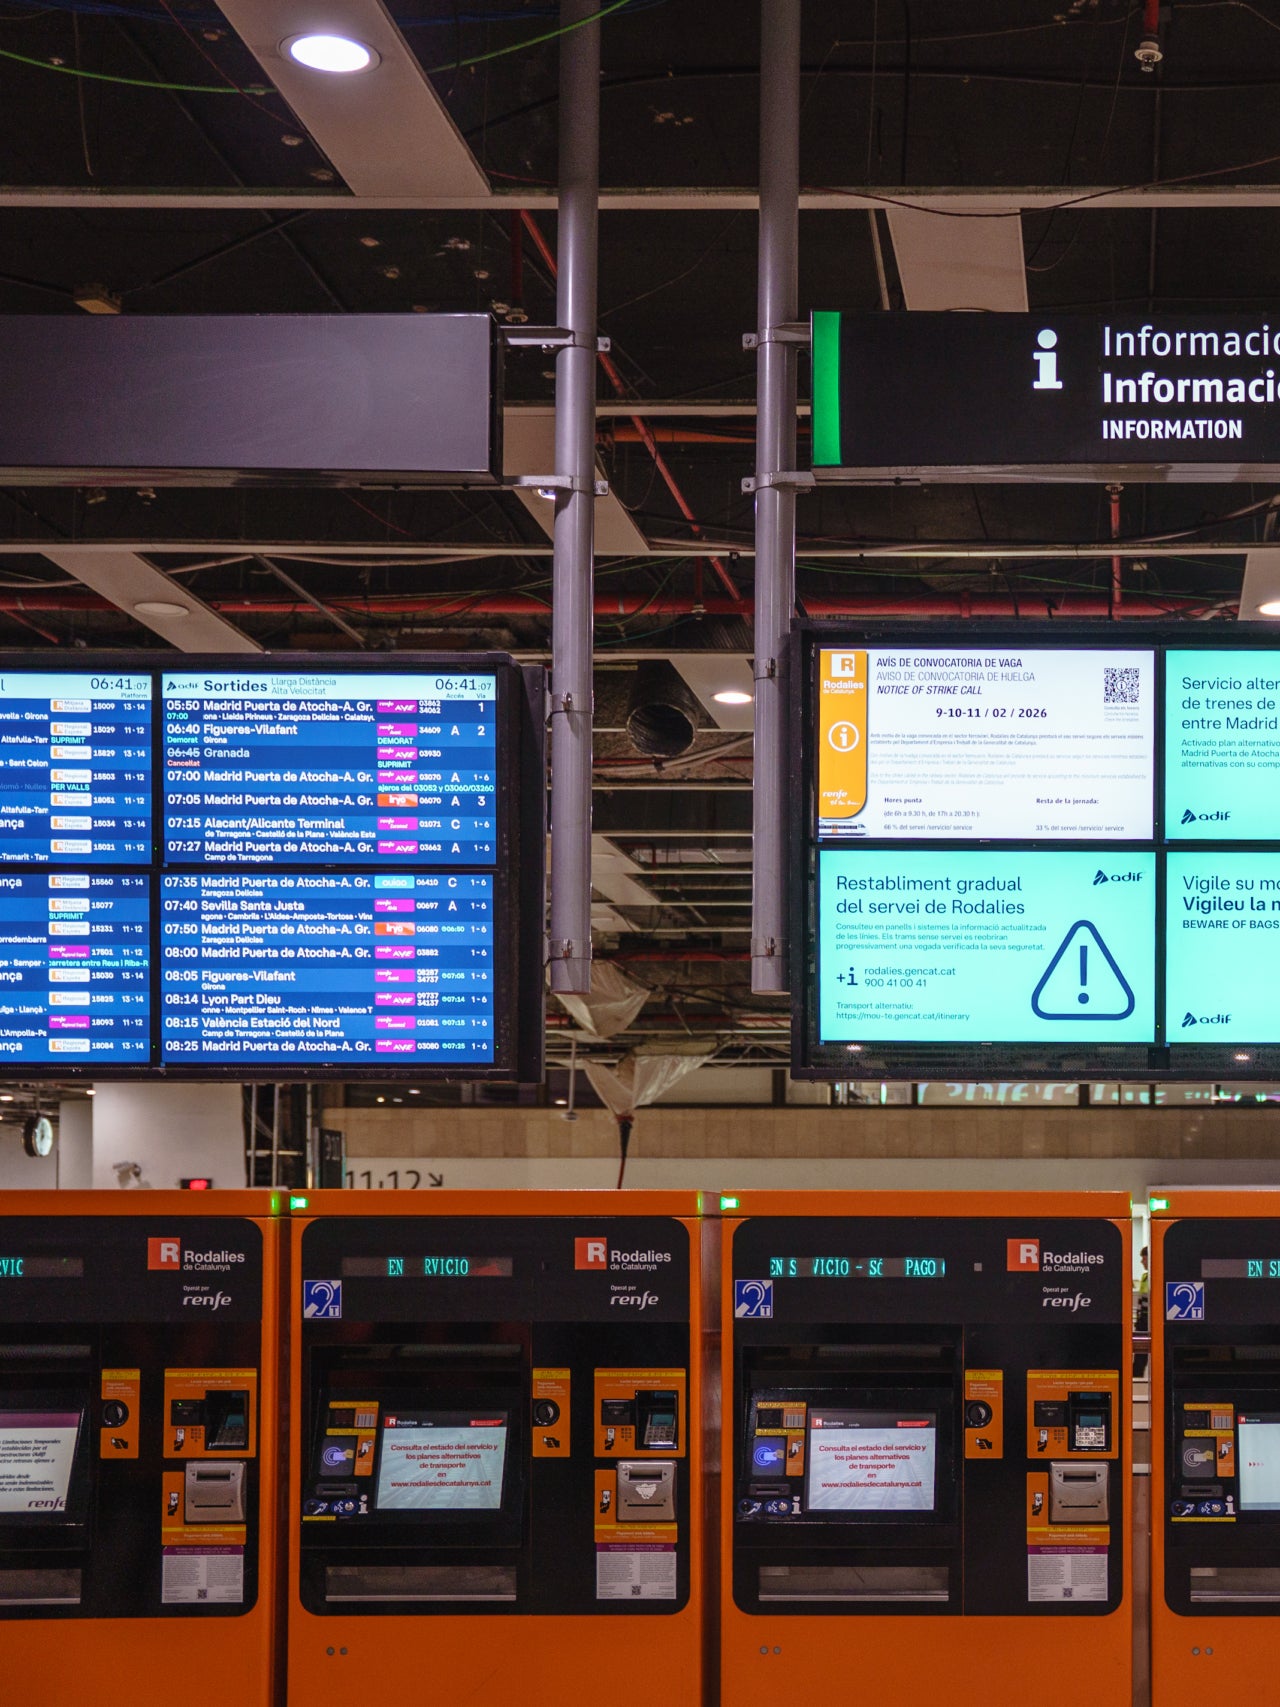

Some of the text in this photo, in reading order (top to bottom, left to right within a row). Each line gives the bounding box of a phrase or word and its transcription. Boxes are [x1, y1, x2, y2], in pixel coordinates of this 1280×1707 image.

[1103, 420, 1242, 439] INFORMATION
[877, 656, 1022, 668] AVÍS DE CONVOCATORIA DE VAGA
[877, 672, 1035, 682] AVISO DE CONVOCATORIA DE HUELGA
[204, 680, 267, 692] Sortides
[271, 678, 336, 687] Llarga Distància
[823, 680, 864, 689] Rodalies
[1183, 677, 1242, 690] Servicio
[271, 687, 326, 695] Alta Velocitat
[878, 686, 982, 695] NOTICE OF STRIKE CALL
[167, 701, 200, 710] 05:50
[204, 700, 373, 711] Madrid Puerta de Atocha-A. Gr.
[1182, 697, 1200, 710] de
[1206, 698, 1252, 710] trenes
[1257, 698, 1275, 710] de
[936, 708, 1047, 718] 9-10-11 / 02 / 2026
[1182, 718, 1221, 729] entre
[1227, 717, 1278, 730] Madrid
[168, 724, 200, 734] 06:40
[204, 724, 298, 735] Figueres-Vilafant
[451, 726, 485, 736] A 2
[204, 748, 250, 758] Granada
[1199, 812, 1230, 820] adif
[168, 818, 201, 828] 07:15
[205, 818, 345, 830] Alacant/Alicante Terminal
[1111, 872, 1142, 881] adif
[838, 876, 1022, 894] Restabliment gradual
[1183, 876, 1230, 894] Vigile
[1236, 880, 1254, 890] su
[165, 901, 198, 910] 07:40
[202, 901, 304, 911] Sevilla Santa Justa
[837, 899, 1024, 914] del servei de Rodalies
[1183, 896, 1244, 914] Vigileu
[1251, 897, 1265, 911] la
[1183, 920, 1228, 928] BEWARE
[1232, 920, 1246, 928] OF
[1250, 920, 1280, 928] BAGS
[865, 967, 956, 977] rodalies.gencat.cat
[865, 979, 884, 987] 900
[900, 979, 913, 987] 00
[166, 994, 198, 1004] 08:14
[202, 994, 281, 1006] Lyon Part Dieu
[837, 1001, 914, 1011] Transport alternatiu:
[836, 1011, 970, 1021] https://mou-te.gencat.cat/itinerary
[1200, 1014, 1231, 1024] adif
[166, 1018, 198, 1028] 08:15
[202, 1018, 340, 1028] València Estació del Nord
[185, 1251, 245, 1262] Rodalies
[612, 1251, 671, 1262] Rodalies
[1044, 1252, 1104, 1264] Rodalies
[388, 1257, 469, 1275] EN RVICIO
[789, 1259, 849, 1276] SVICIO
[905, 1258, 936, 1276] PAGO
[1054, 1265, 1090, 1273] Catalunya
[1248, 1261, 1263, 1277] EN
[184, 1290, 232, 1310] renfe
[611, 1290, 658, 1310] renfe
[1043, 1291, 1091, 1312] renfe
